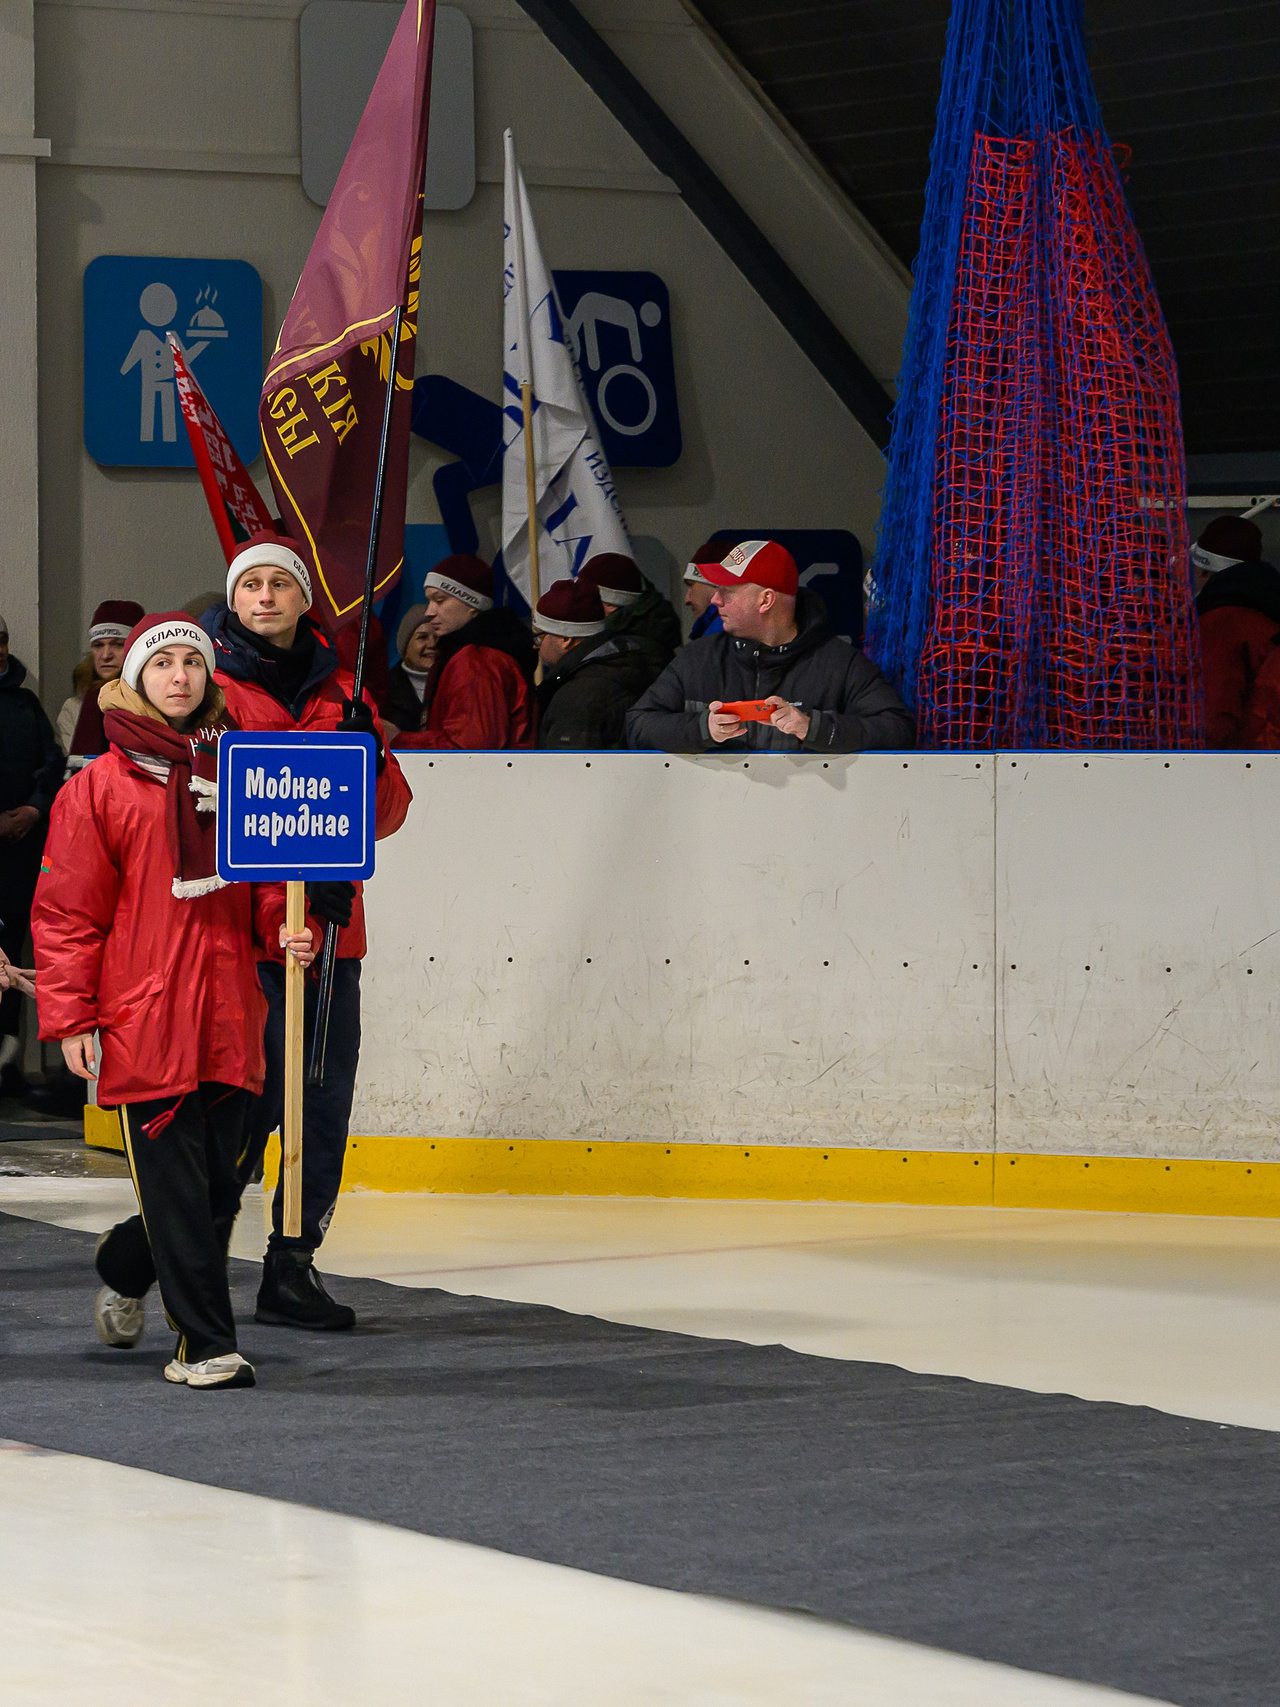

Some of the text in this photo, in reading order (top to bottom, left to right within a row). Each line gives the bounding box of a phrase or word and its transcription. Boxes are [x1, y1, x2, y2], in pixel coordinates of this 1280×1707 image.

[267, 387, 320, 460] СЫ
[295, 360, 358, 446] КІЯ
[145, 628, 202, 648] БЕЛАРУСЬ
[245, 766, 331, 800] Моднае
[244, 803, 350, 847] народнае
